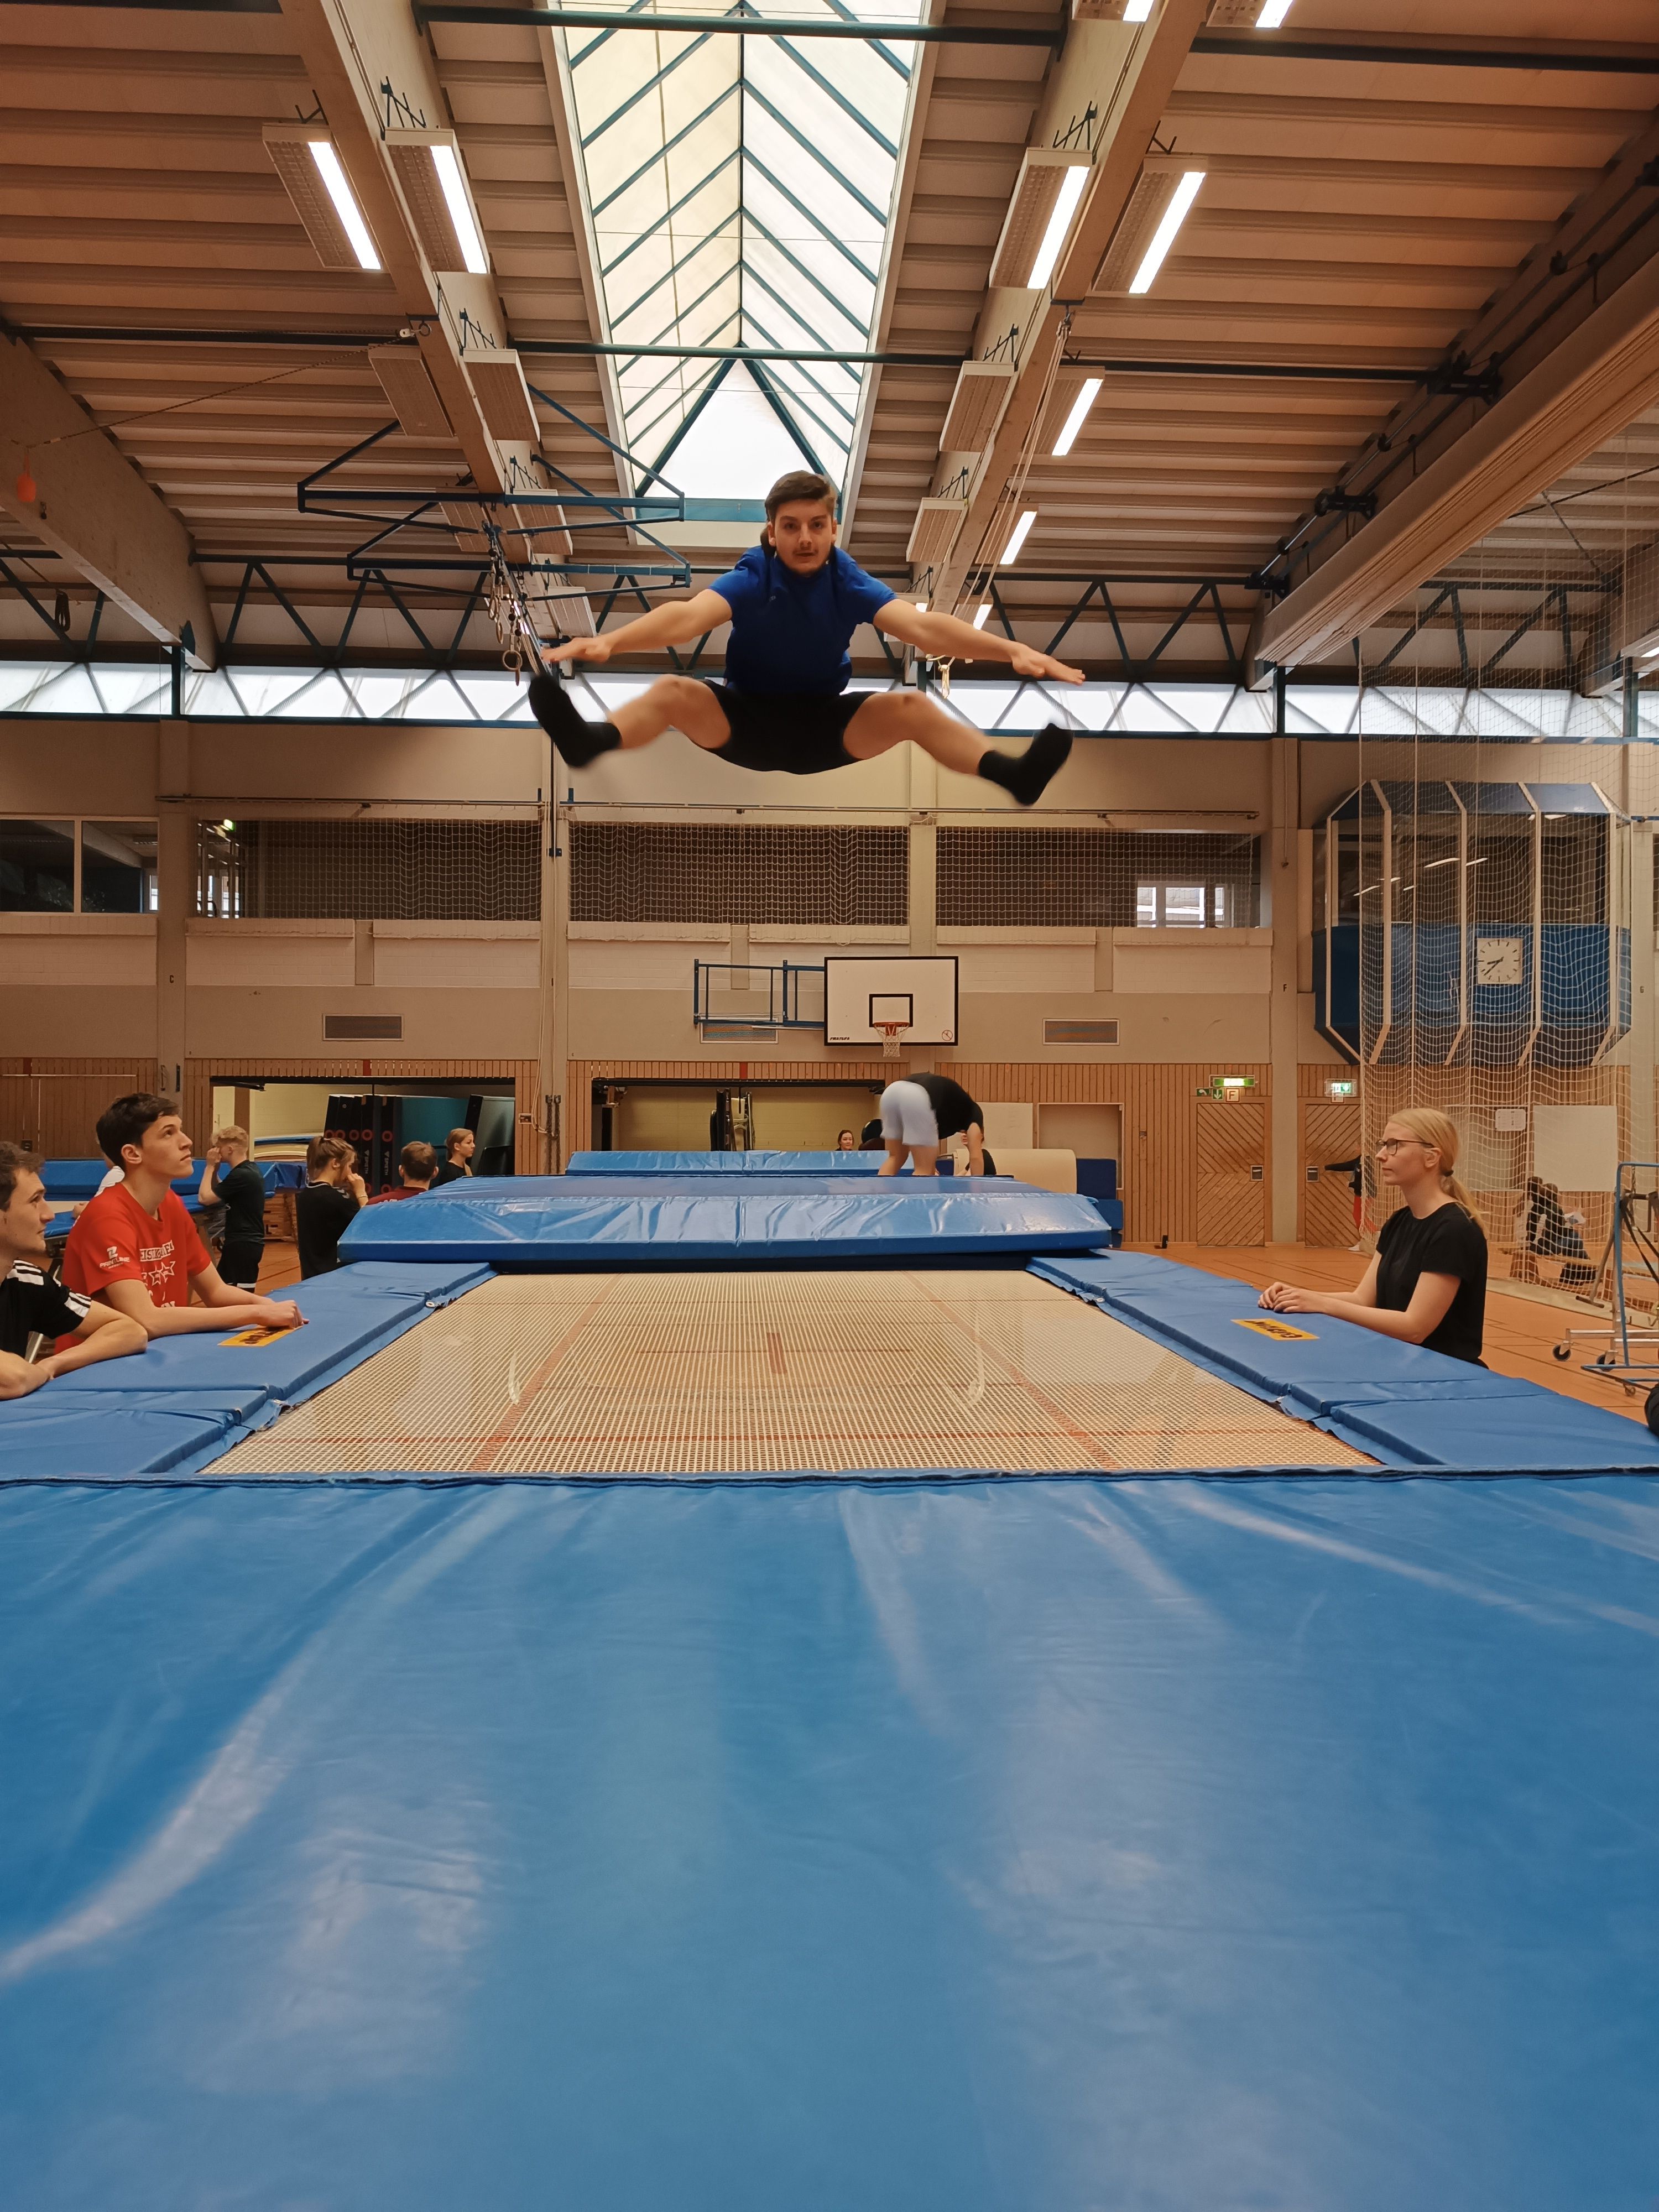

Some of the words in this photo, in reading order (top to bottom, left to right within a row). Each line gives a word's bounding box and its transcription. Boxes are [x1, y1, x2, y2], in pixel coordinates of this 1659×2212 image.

[169, 975, 174, 983] C
[1283, 984, 1287, 992] F
[1229, 1091, 1237, 1100] F
